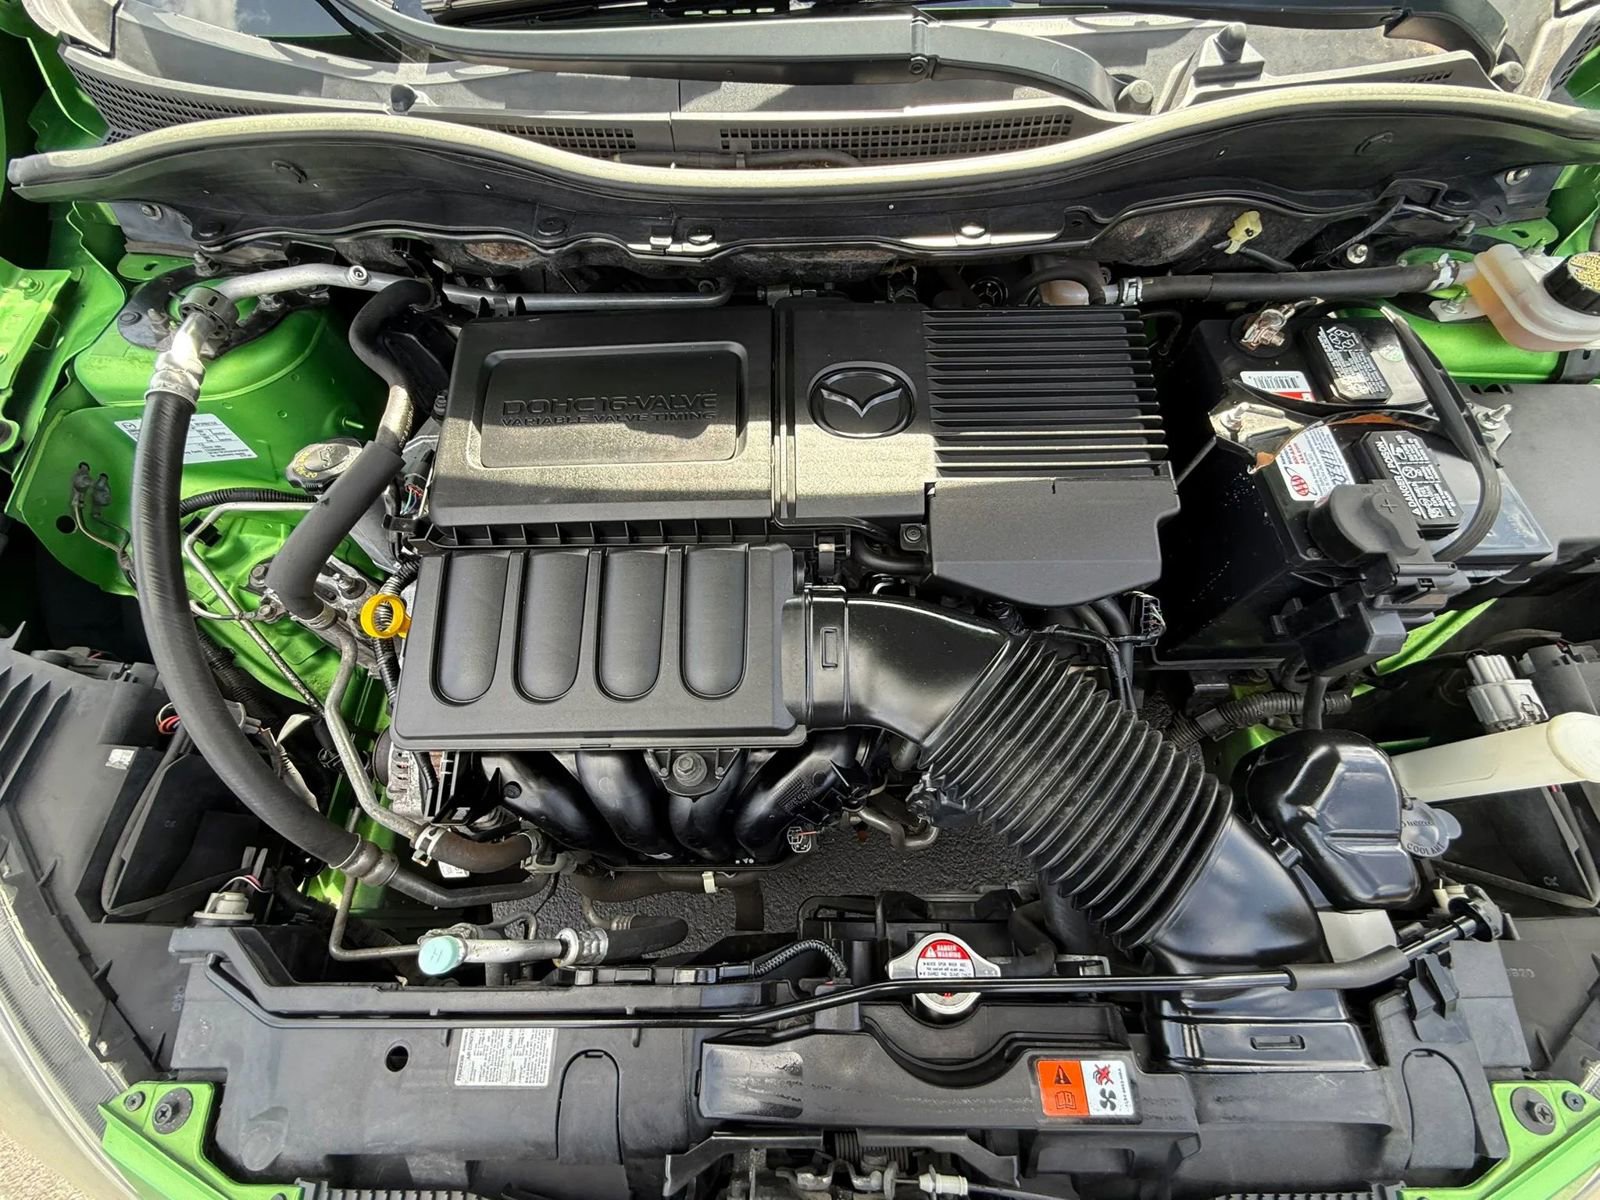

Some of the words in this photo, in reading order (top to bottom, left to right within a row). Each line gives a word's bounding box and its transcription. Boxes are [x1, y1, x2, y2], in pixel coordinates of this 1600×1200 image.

[502, 398, 595, 416] DOHC
[600, 393, 718, 413] 16-VALVE
[501, 415, 588, 427] VARIABLE
[595, 413, 649, 424] VALVE
[652, 411, 717, 422] TIMING
[1376, 441, 1395, 468] POISON
[1393, 475, 1416, 507] DANGER
[1407, 842, 1445, 855] COOLANT
